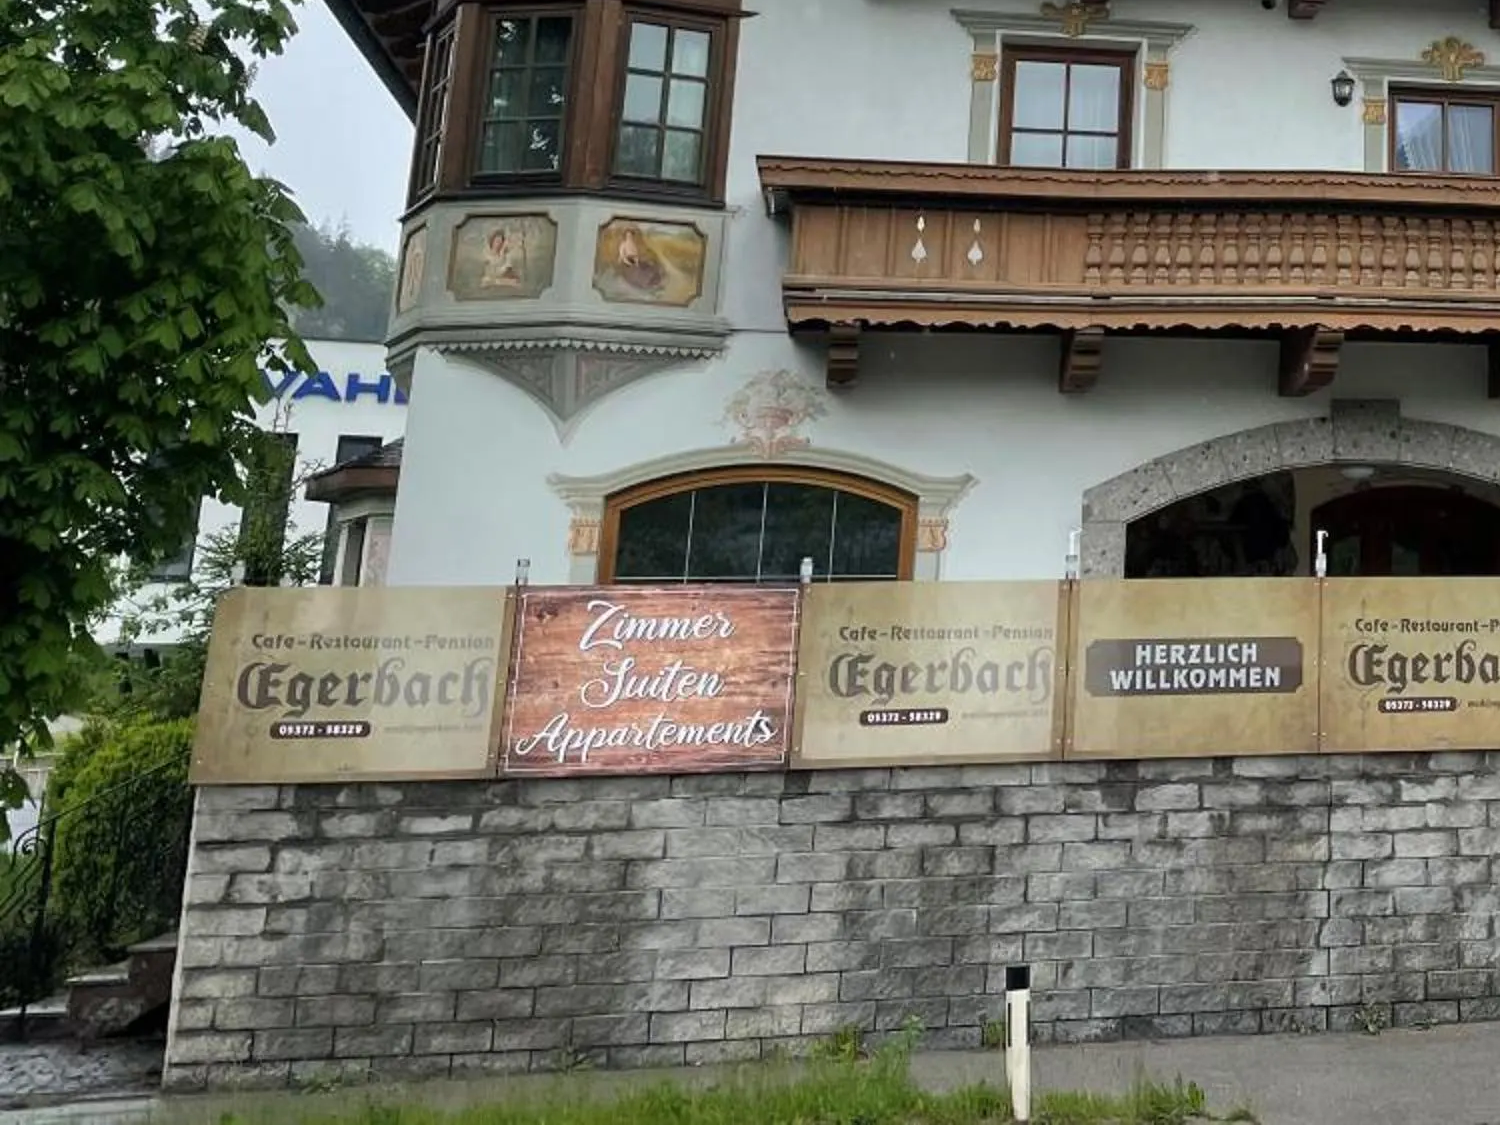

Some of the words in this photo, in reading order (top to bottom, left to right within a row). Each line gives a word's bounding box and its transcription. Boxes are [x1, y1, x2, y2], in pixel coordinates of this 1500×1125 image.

[579, 600, 735, 651] Zimmer
[828, 646, 1055, 706] Egerbach
[1110, 666, 1281, 690] WILLKOMMEN
[1135, 643, 1258, 667] HERZLICH
[237, 656, 494, 718] Egerbach
[581, 657, 725, 709] Suiten
[515, 709, 777, 763] Appartements
